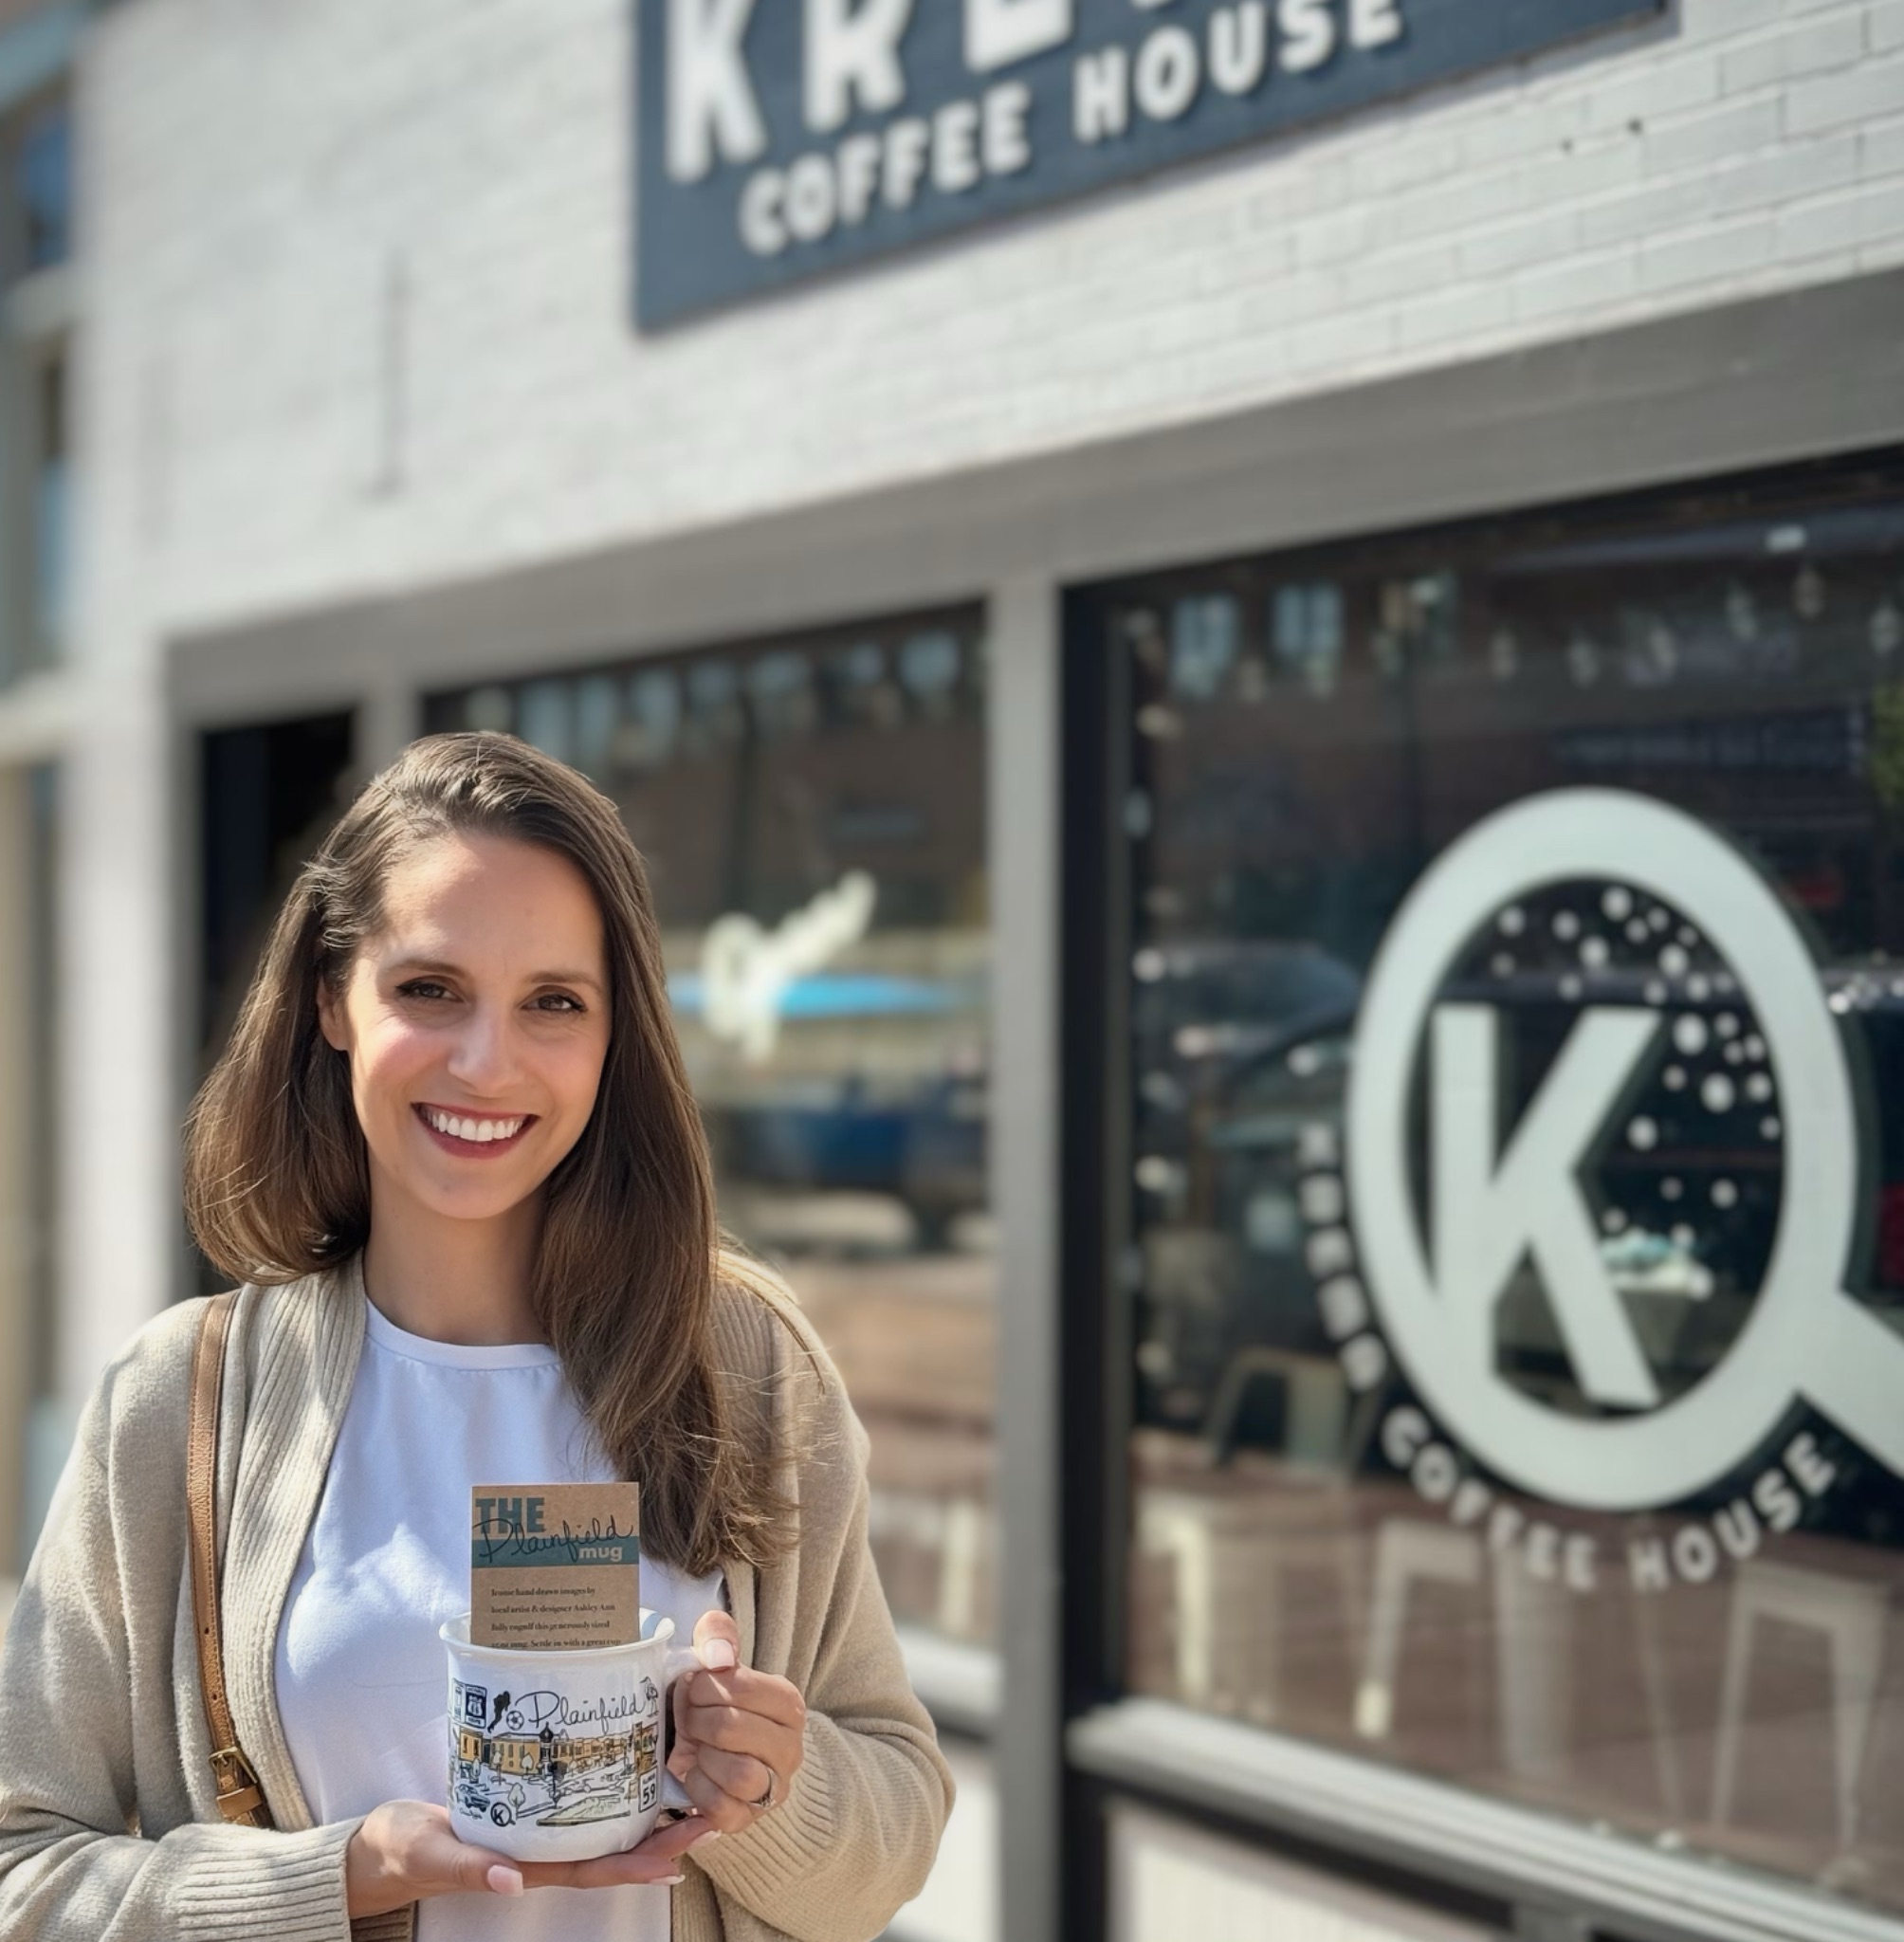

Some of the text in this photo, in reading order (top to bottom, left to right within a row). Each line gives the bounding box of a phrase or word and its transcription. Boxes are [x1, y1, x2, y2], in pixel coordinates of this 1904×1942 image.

[740, 0, 1402, 254] COFFEE HOUSE
[1381, 1405, 1836, 1593] COFFEE HOUSE
[476, 1497, 544, 1533] THE
[472, 1514, 633, 1563] Plainfield
[578, 1546, 623, 1562] mug
[586, 1586, 595, 1596] by
[531, 1604, 539, 1613] &
[540, 1604, 572, 1614] designer
[574, 1603, 598, 1613] Ashley
[534, 1621, 549, 1630] this
[549, 1621, 590, 1631] generously
[591, 1620, 610, 1628] sized
[562, 1638, 580, 1646] with
[586, 1639, 606, 1647] great
[514, 1691, 647, 1736] Plainfield
[642, 1783, 655, 1805] 59
